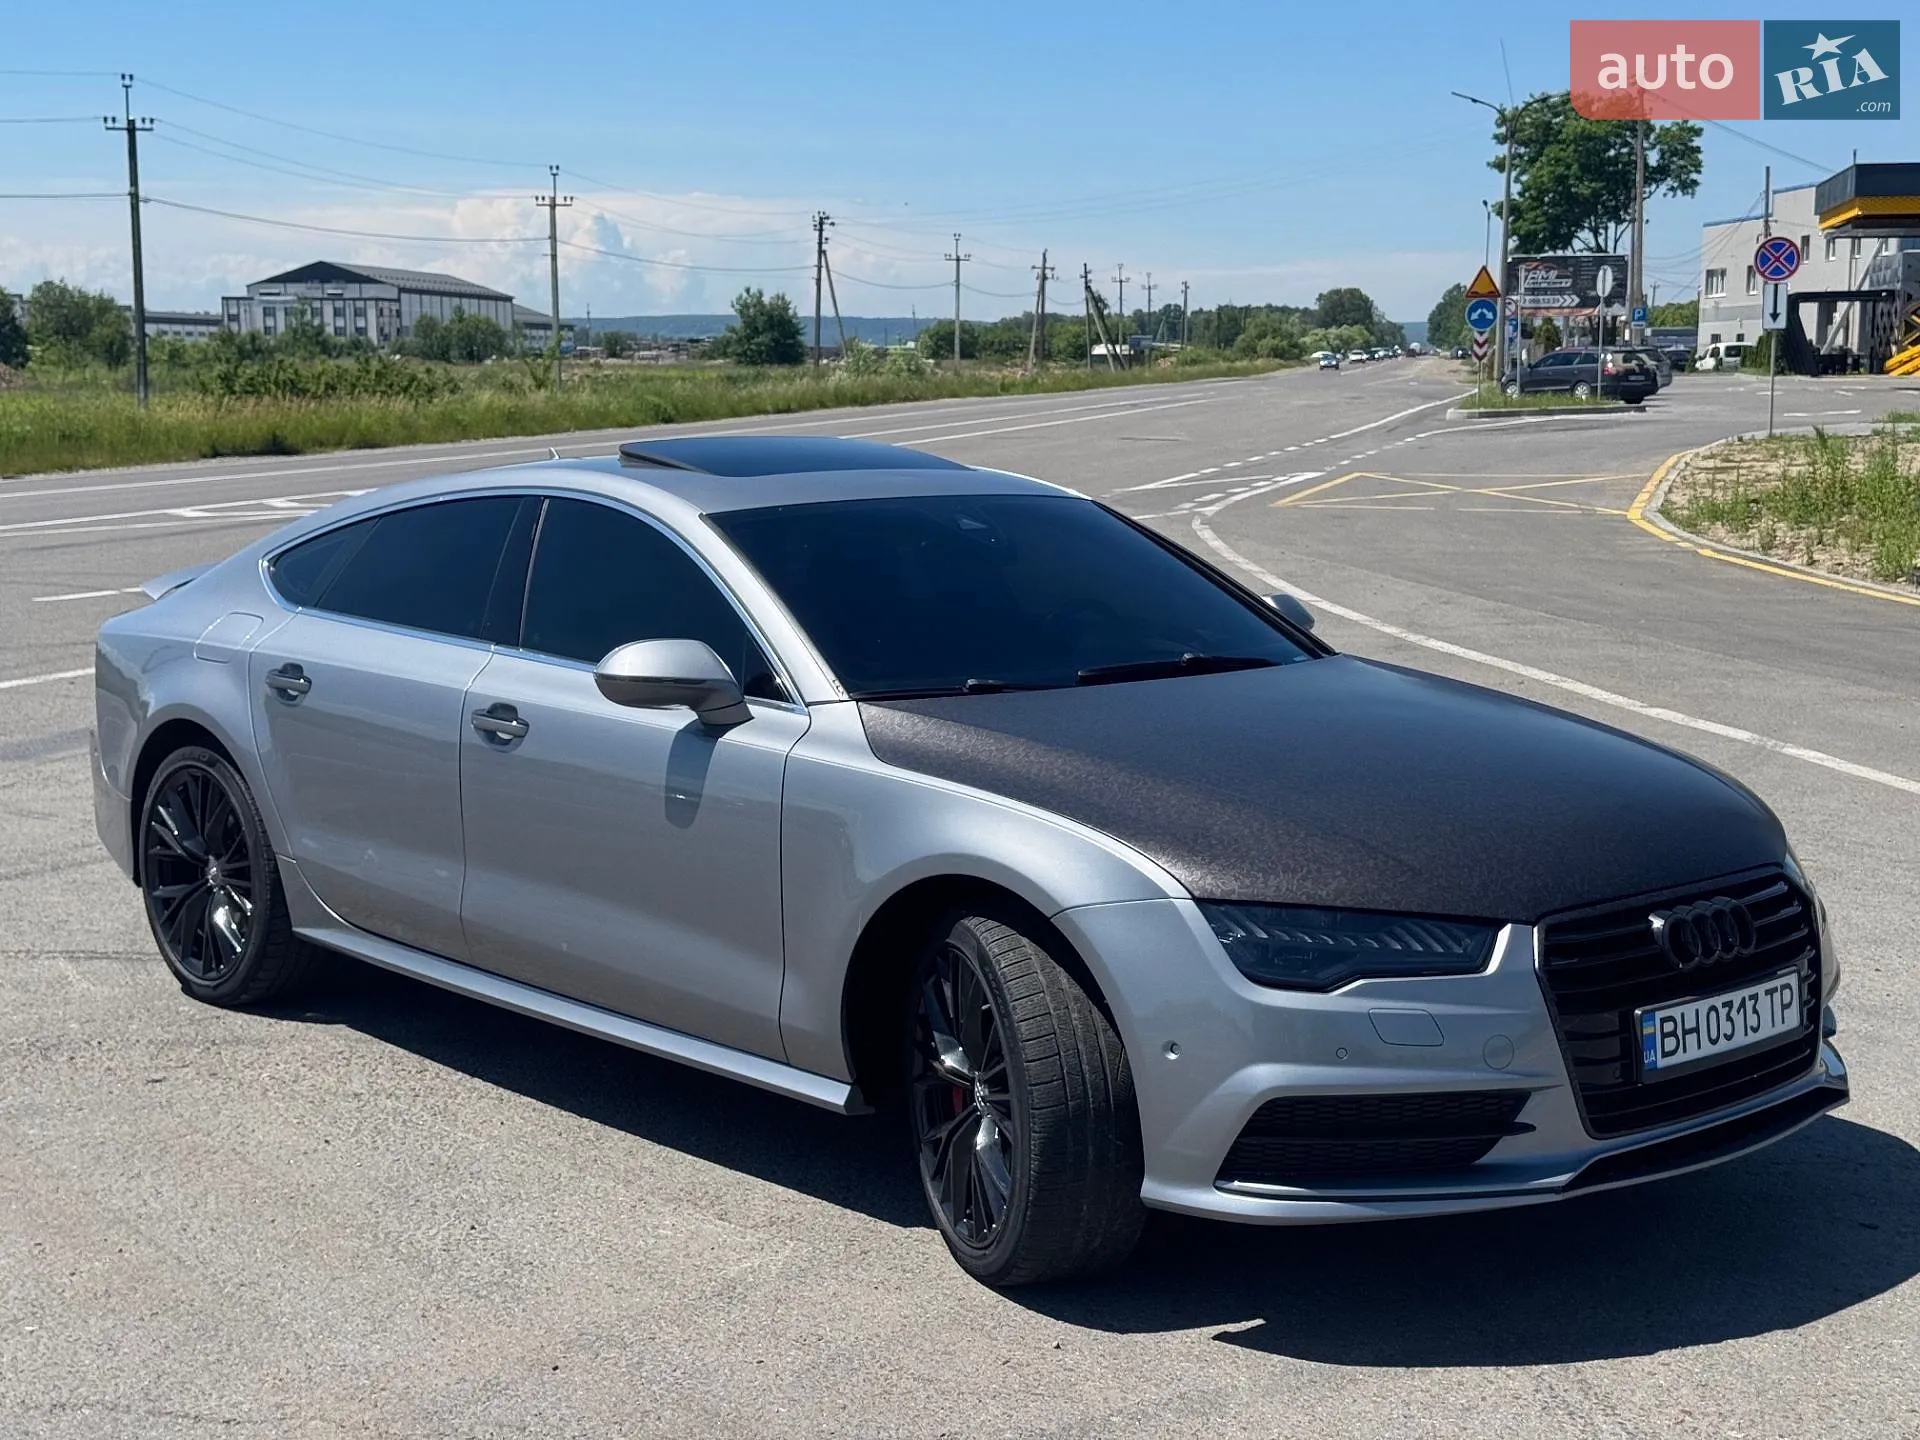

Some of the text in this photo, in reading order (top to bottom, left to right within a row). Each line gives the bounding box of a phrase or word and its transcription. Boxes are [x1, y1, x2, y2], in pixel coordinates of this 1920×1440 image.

[1660, 983, 1793, 1059] BH 0313 TP
[1643, 1050, 1657, 1064] UA
